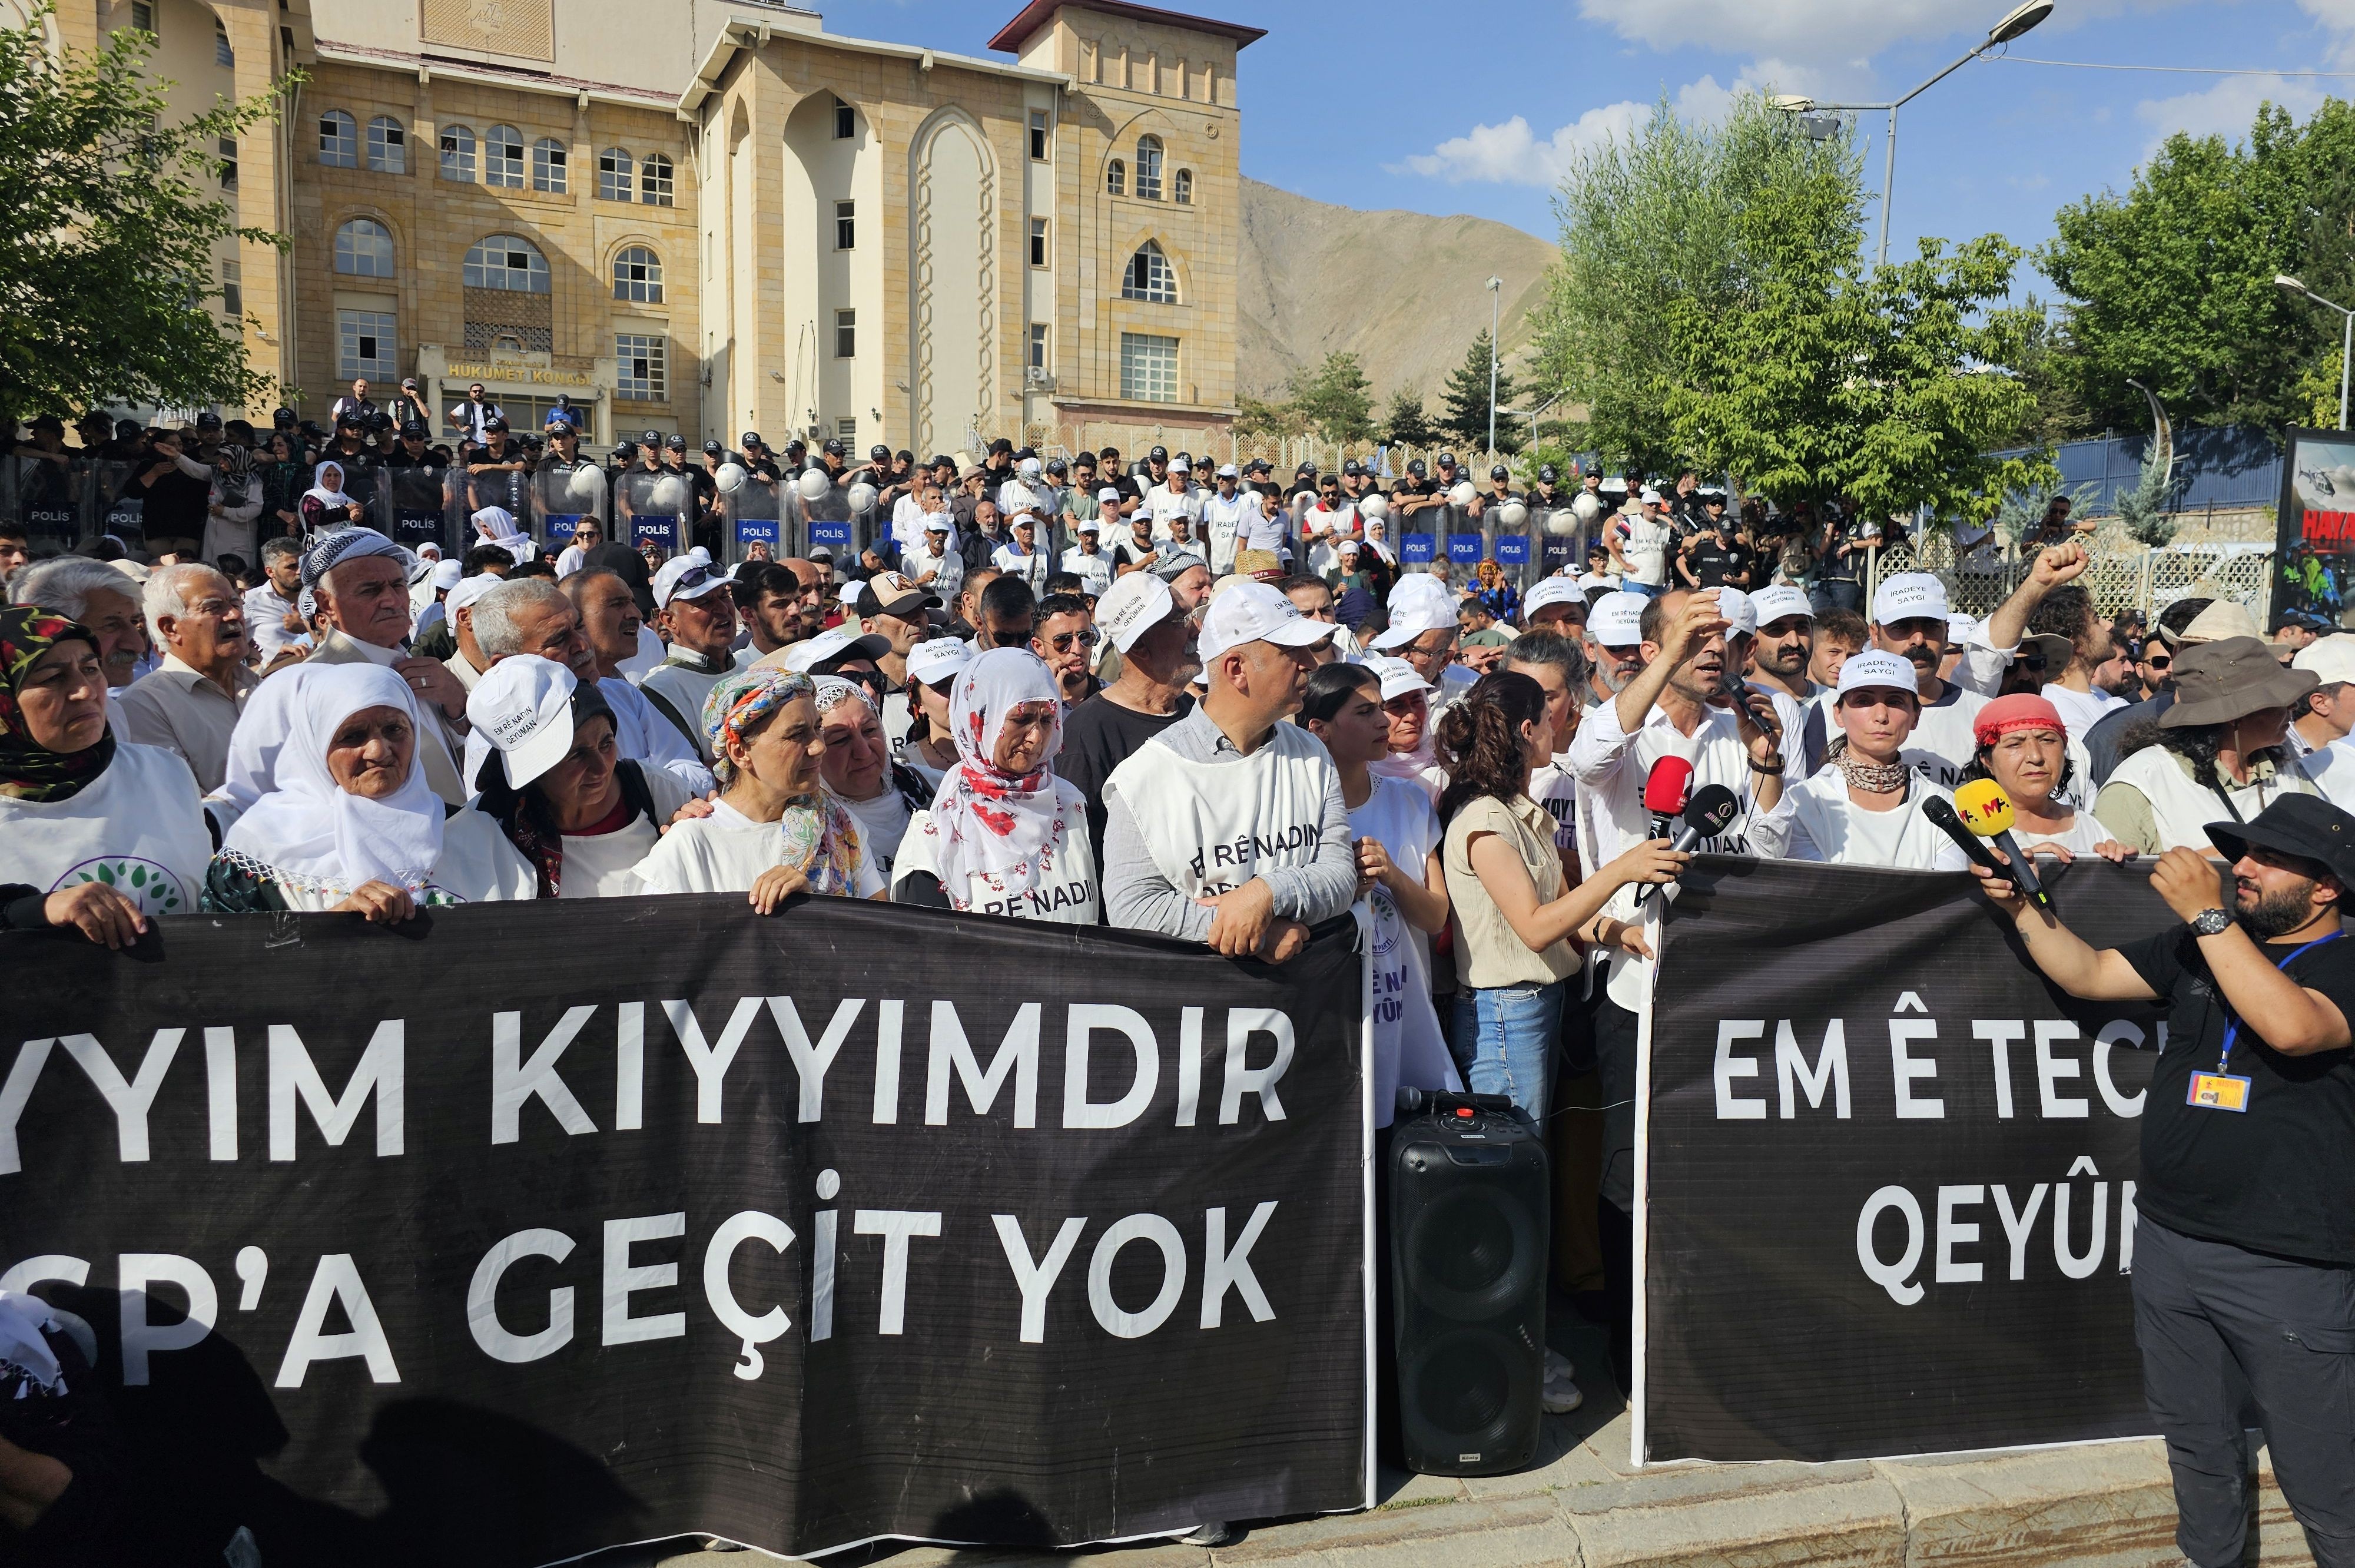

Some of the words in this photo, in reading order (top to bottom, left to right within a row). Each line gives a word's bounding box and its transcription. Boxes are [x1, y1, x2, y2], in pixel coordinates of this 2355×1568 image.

[449, 362, 525, 382] HÜKÜMET
[31, 510, 69, 521] POLİS
[111, 513, 142, 523] POLİ
[402, 516, 435, 529] POLİS
[554, 521, 577, 532] POLİ
[638, 524, 669, 535] POLİS
[742, 526, 771, 536] POLİS
[815, 528, 844, 538] POLİS
[1125, 594, 1142, 611] NADIN
[1898, 595, 1925, 604] SAYGI
[934, 649, 960, 659] SAYGI
[493, 726, 504, 735] EM
[502, 719, 513, 731] RÊ
[511, 705, 533, 725] NADIN
[1214, 834, 1250, 867] RÊ
[1713, 1017, 1852, 1120] EM
[1888, 990, 1945, 1119] Ê
[492, 996, 1297, 1145] KIYYIMDIR
[467, 1168, 942, 1381] GEÇİT
[990, 1200, 1279, 1344] YOK
